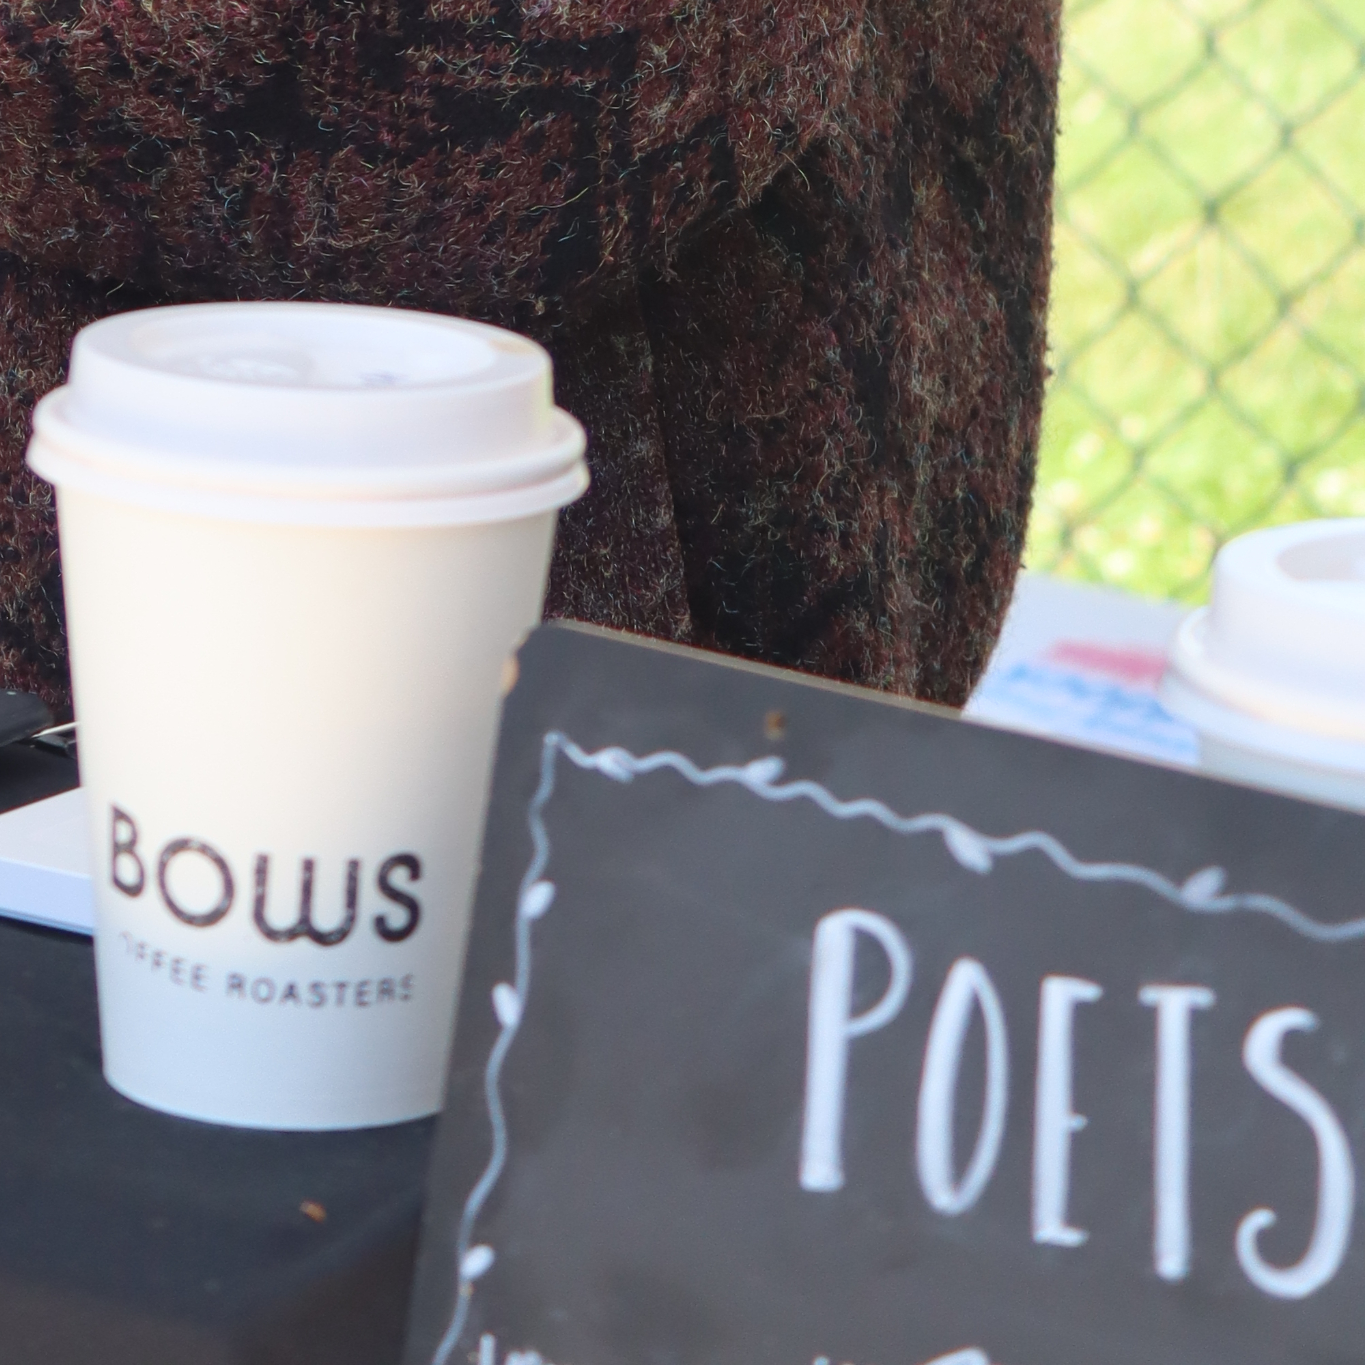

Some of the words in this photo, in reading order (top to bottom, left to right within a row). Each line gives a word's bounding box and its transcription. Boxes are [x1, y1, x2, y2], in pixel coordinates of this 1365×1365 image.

[109, 802, 423, 948] BOWS
[225, 971, 415, 1010] ROASTERS
[798, 907, 1356, 1299] POETS
